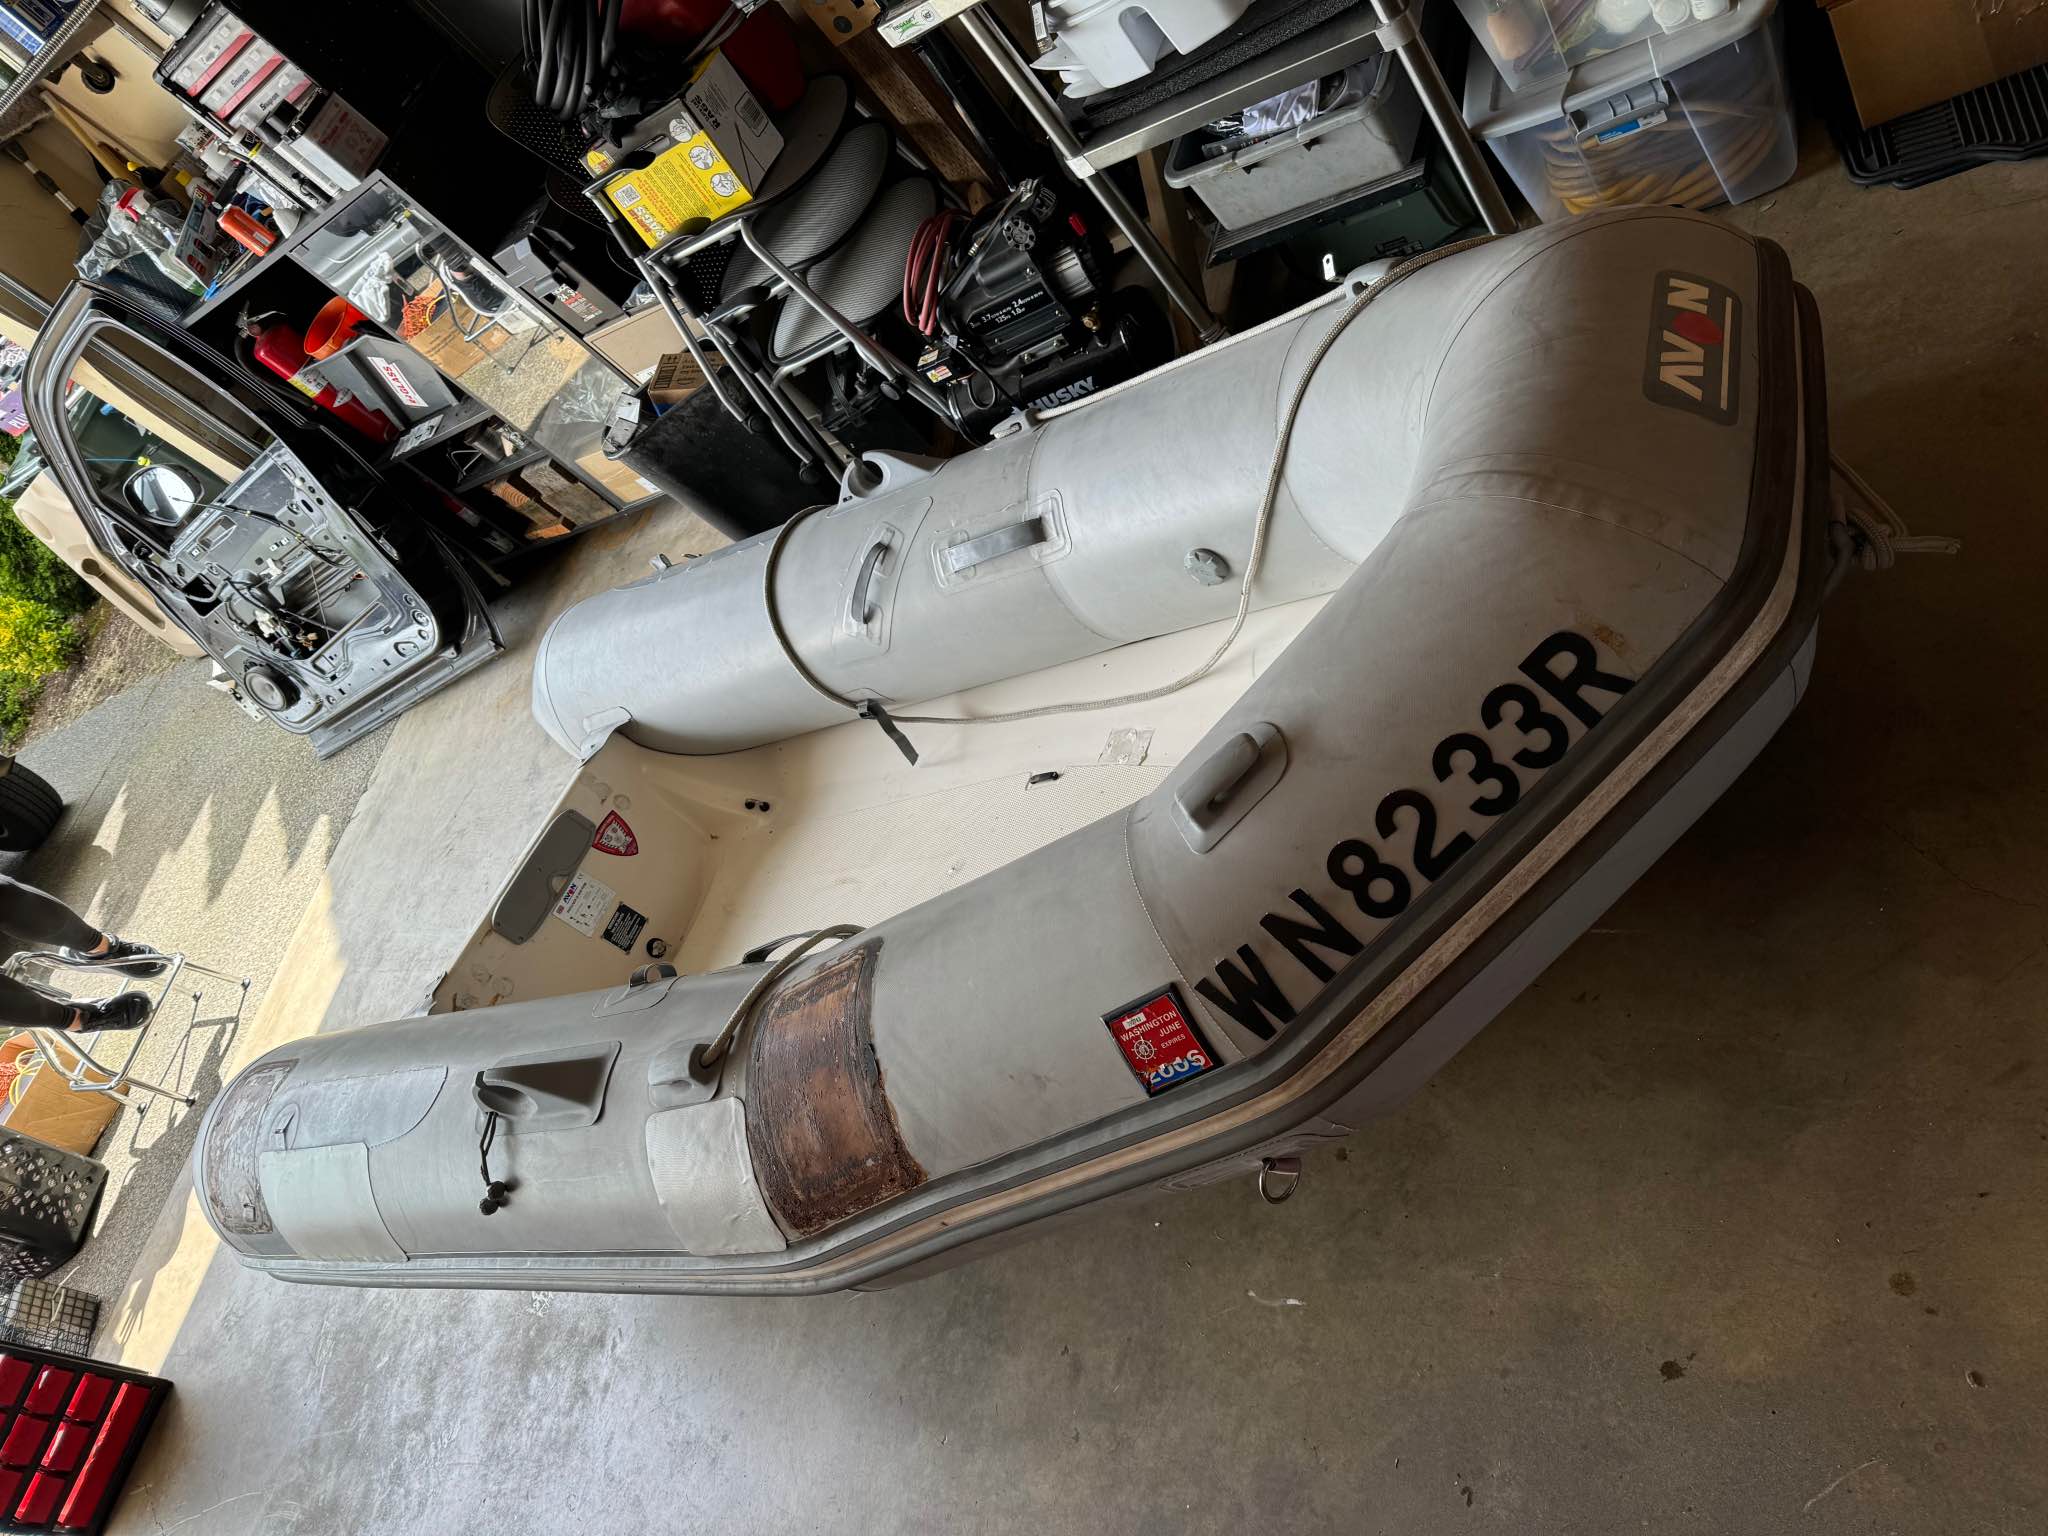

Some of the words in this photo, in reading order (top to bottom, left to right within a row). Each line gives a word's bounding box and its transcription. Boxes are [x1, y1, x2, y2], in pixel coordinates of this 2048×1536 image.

[1660, 278, 1724, 401] AVON
[1028, 376, 1095, 412] HUSKY
[1120, 1010, 1177, 1042] WASHINGTON
[1159, 1022, 1182, 1037] JUNE
[1161, 1034, 1186, 1049] EXPIRES
